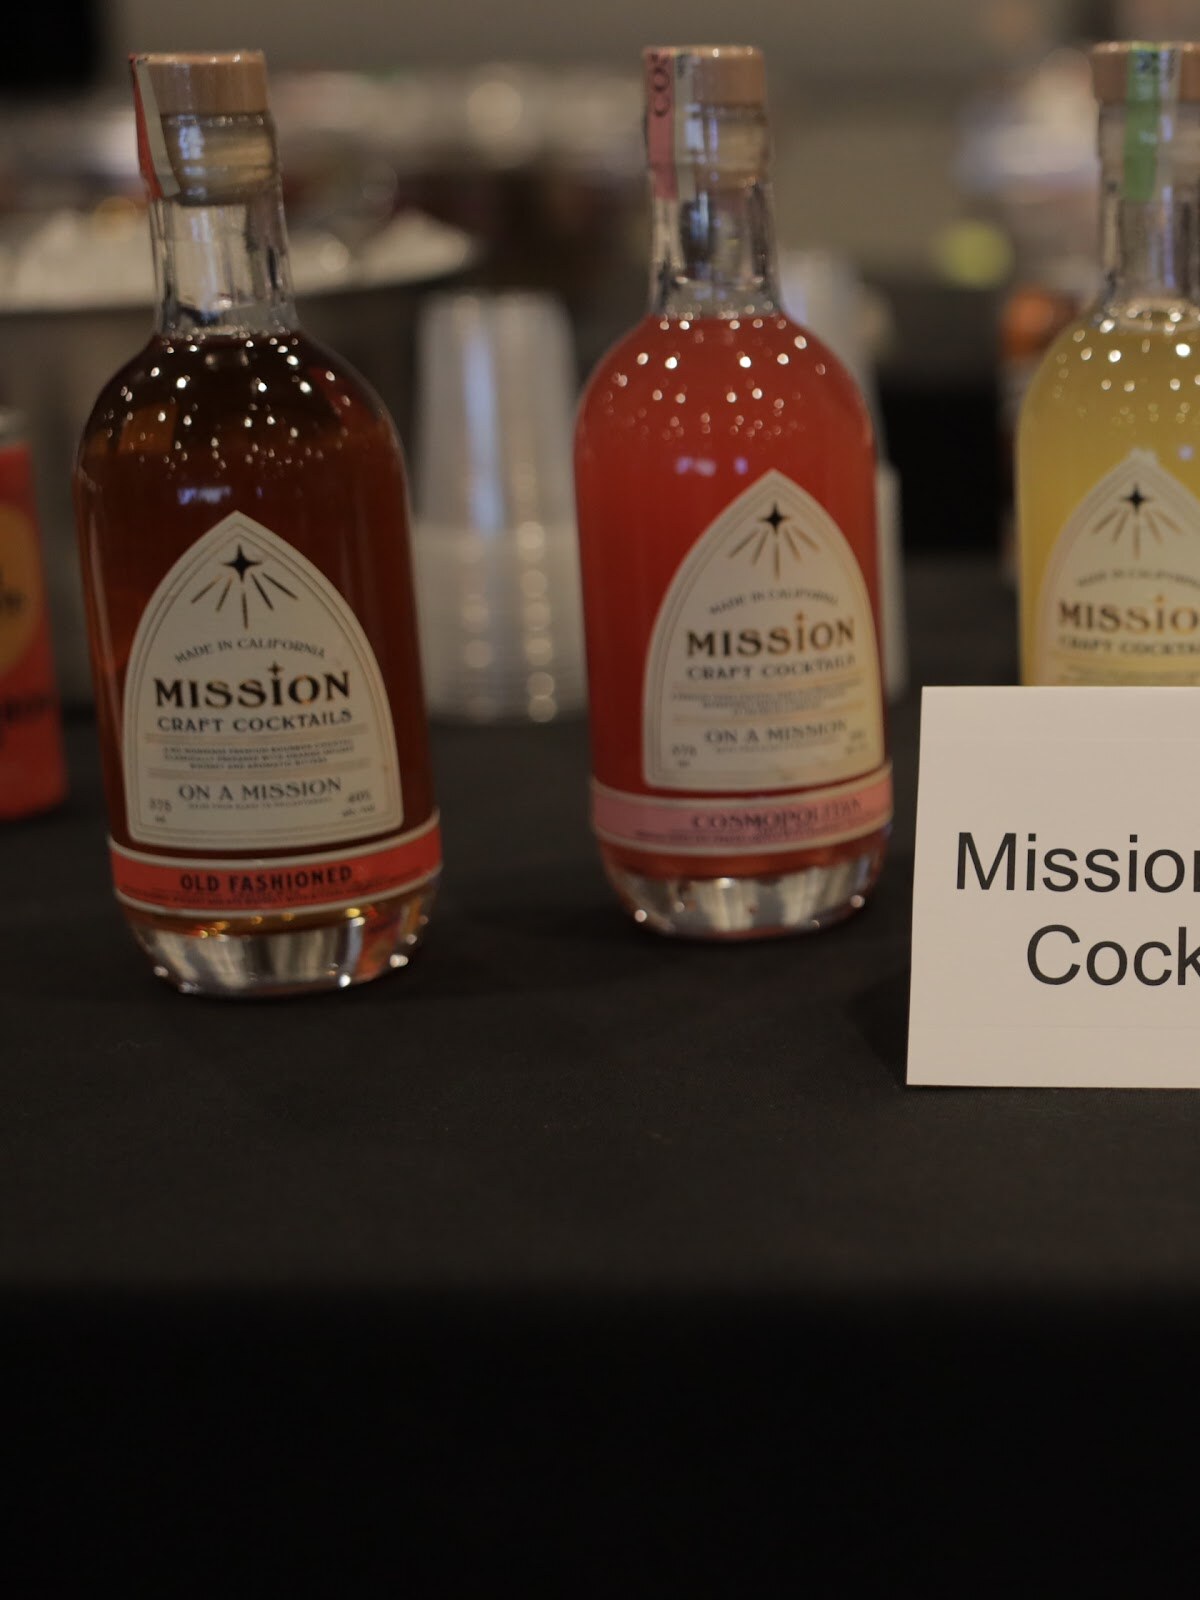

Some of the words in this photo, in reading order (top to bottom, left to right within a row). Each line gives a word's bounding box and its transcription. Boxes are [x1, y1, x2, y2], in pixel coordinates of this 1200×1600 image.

[686, 610, 855, 659] MISSION
[175, 644, 213, 664] MADE
[218, 640, 233, 651] IN
[237, 638, 325, 658] CALIFORNIA
[154, 660, 351, 709] MISSION
[688, 664, 752, 681] CRAFT
[157, 716, 225, 733] CRAFT
[233, 708, 352, 732] COCKTAILS
[705, 728, 738, 743] ON
[747, 728, 759, 743] A
[178, 783, 211, 801] ON
[219, 785, 234, 801] A
[242, 777, 342, 800] MISSION
[692, 798, 862, 829] COSMOPOLITAN
[180, 873, 221, 892] OLD
[228, 865, 353, 893] FASHIONED
